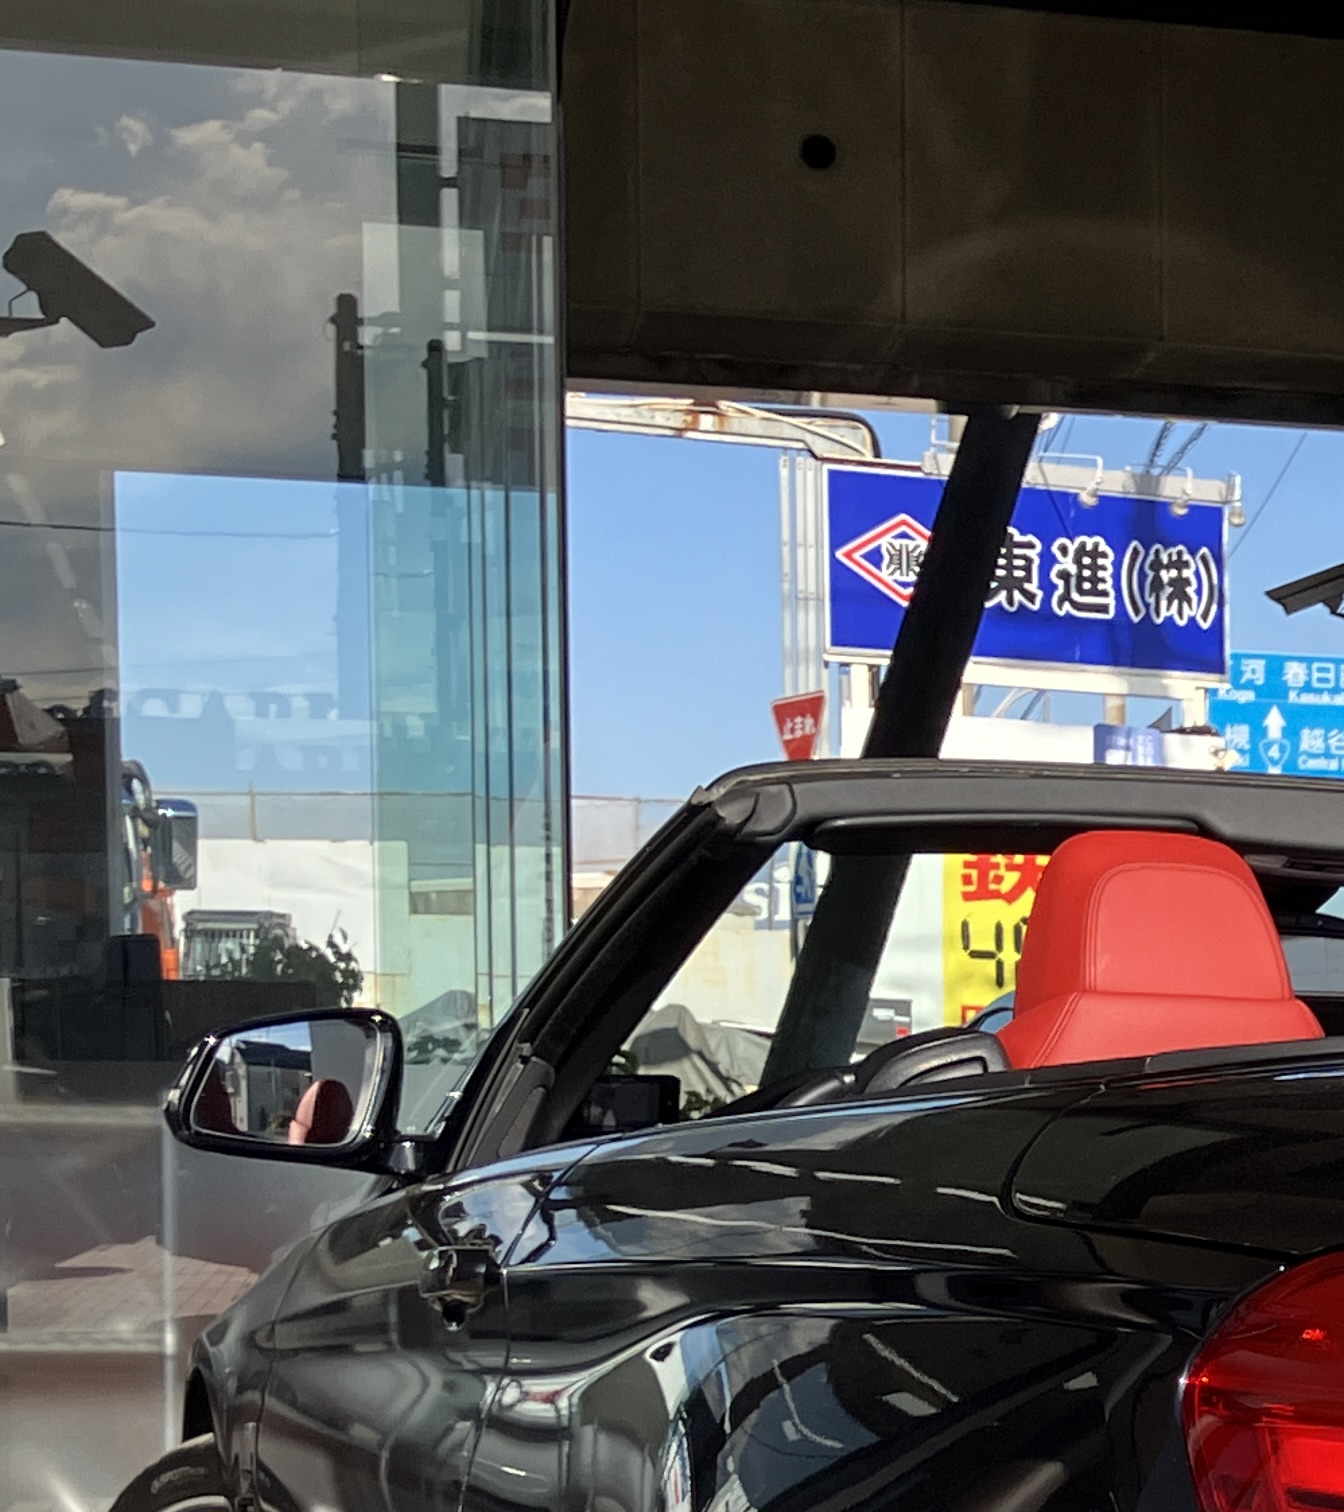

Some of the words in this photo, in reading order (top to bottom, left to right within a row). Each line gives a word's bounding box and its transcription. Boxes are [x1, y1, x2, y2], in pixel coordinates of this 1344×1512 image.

[782, 713, 817, 740] 止まれ
[1267, 743, 1281, 761] 4
